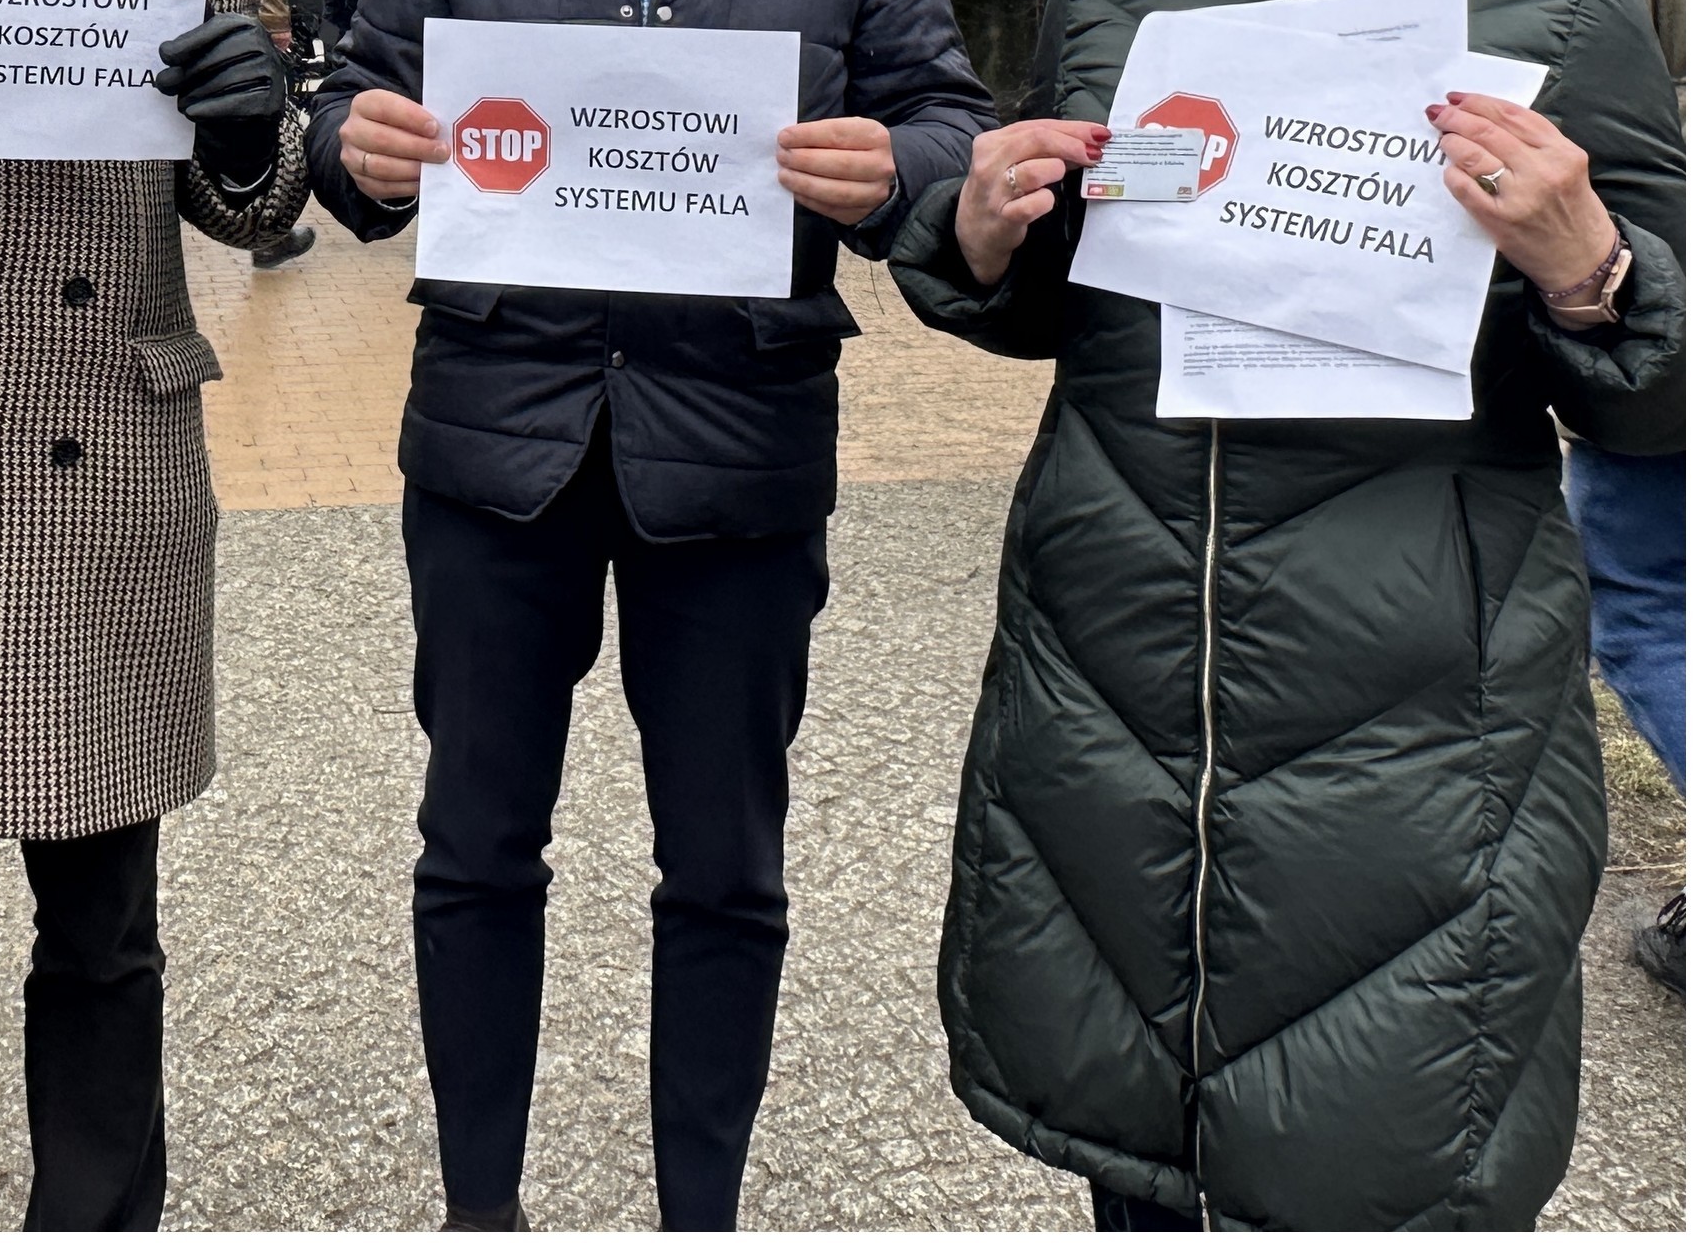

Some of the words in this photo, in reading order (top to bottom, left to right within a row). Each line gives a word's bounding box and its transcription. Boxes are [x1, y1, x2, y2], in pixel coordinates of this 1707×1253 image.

[94, 68, 157, 88] FALA
[571, 107, 738, 135] WZROSTOWI
[461, 127, 542, 162] STOP
[588, 148, 719, 174] KOSZTÓW
[1266, 162, 1415, 208] KOSZTÓW
[555, 187, 676, 213] SYSTEMU
[686, 193, 749, 216] FALA
[1220, 200, 1353, 246] SYSTEMU
[1359, 225, 1434, 263] FALA
